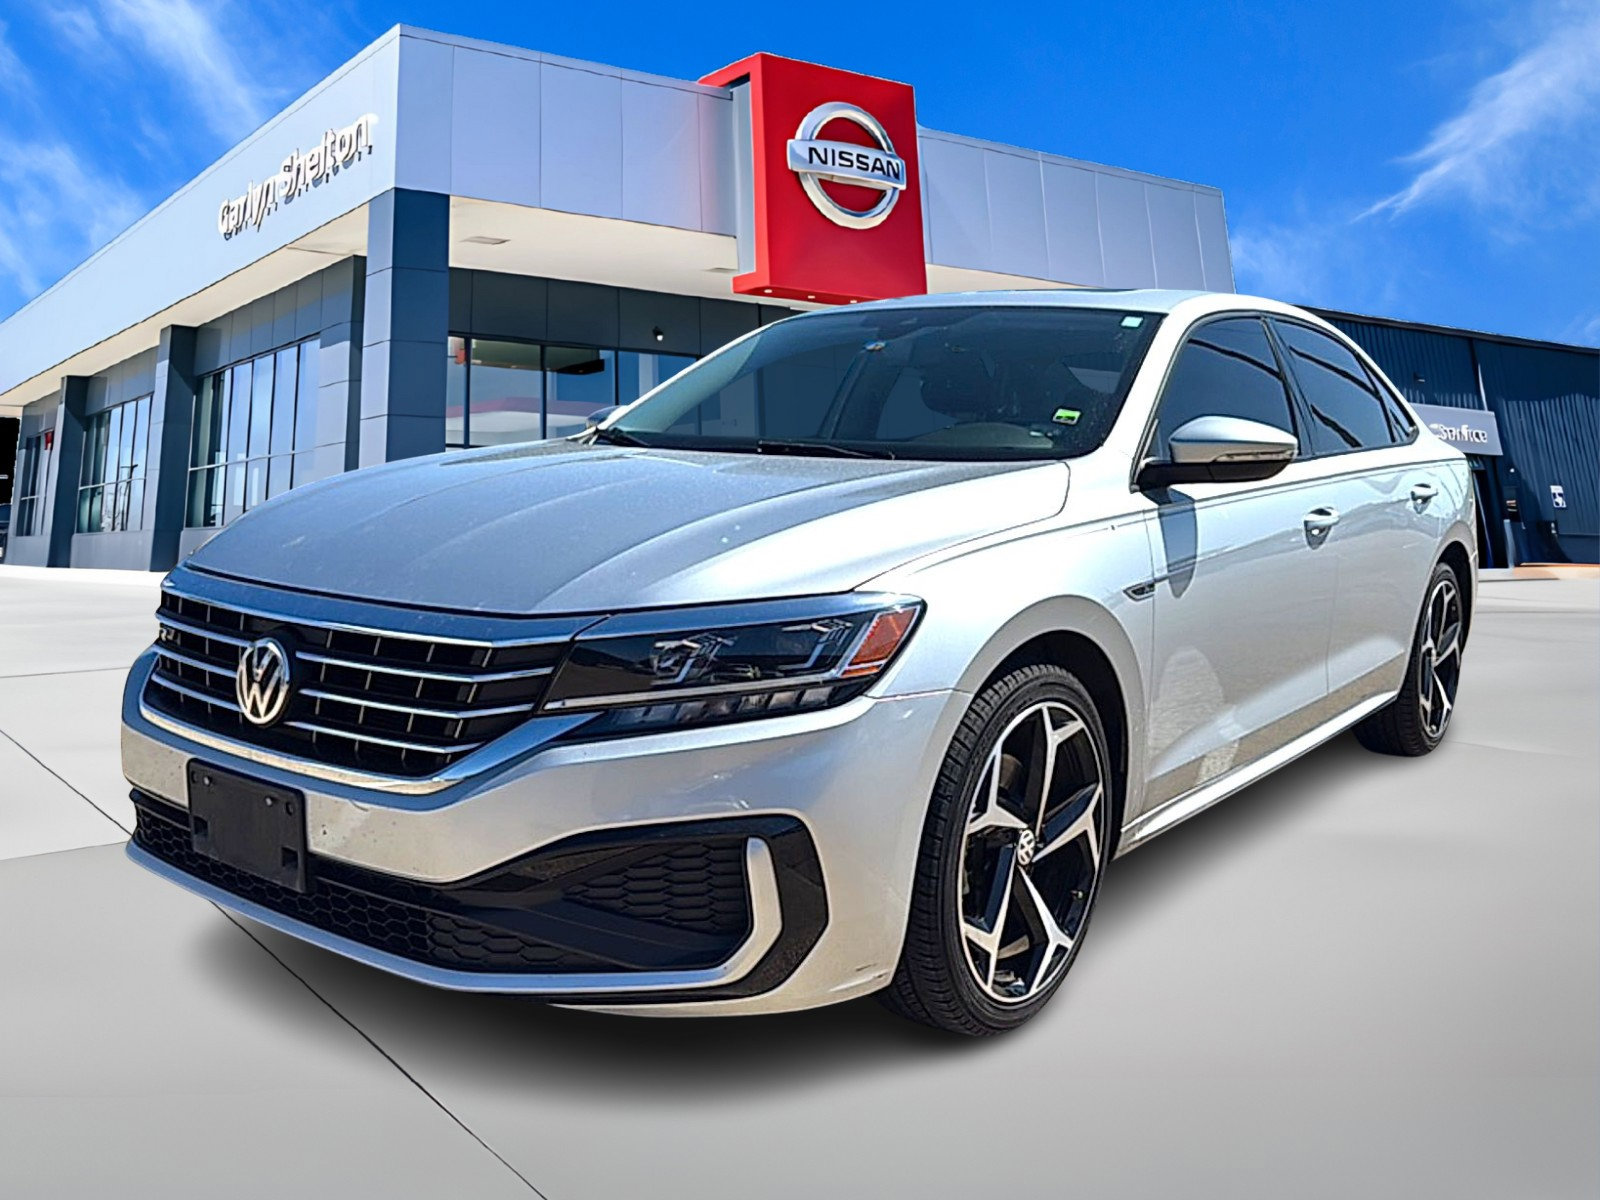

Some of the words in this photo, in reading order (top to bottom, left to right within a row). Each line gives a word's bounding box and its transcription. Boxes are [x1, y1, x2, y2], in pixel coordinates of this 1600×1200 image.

[278, 114, 373, 203] Shelton
[808, 146, 900, 181] NISSAN
[1431, 423, 1488, 443] Service
[238, 641, 288, 721] VW
